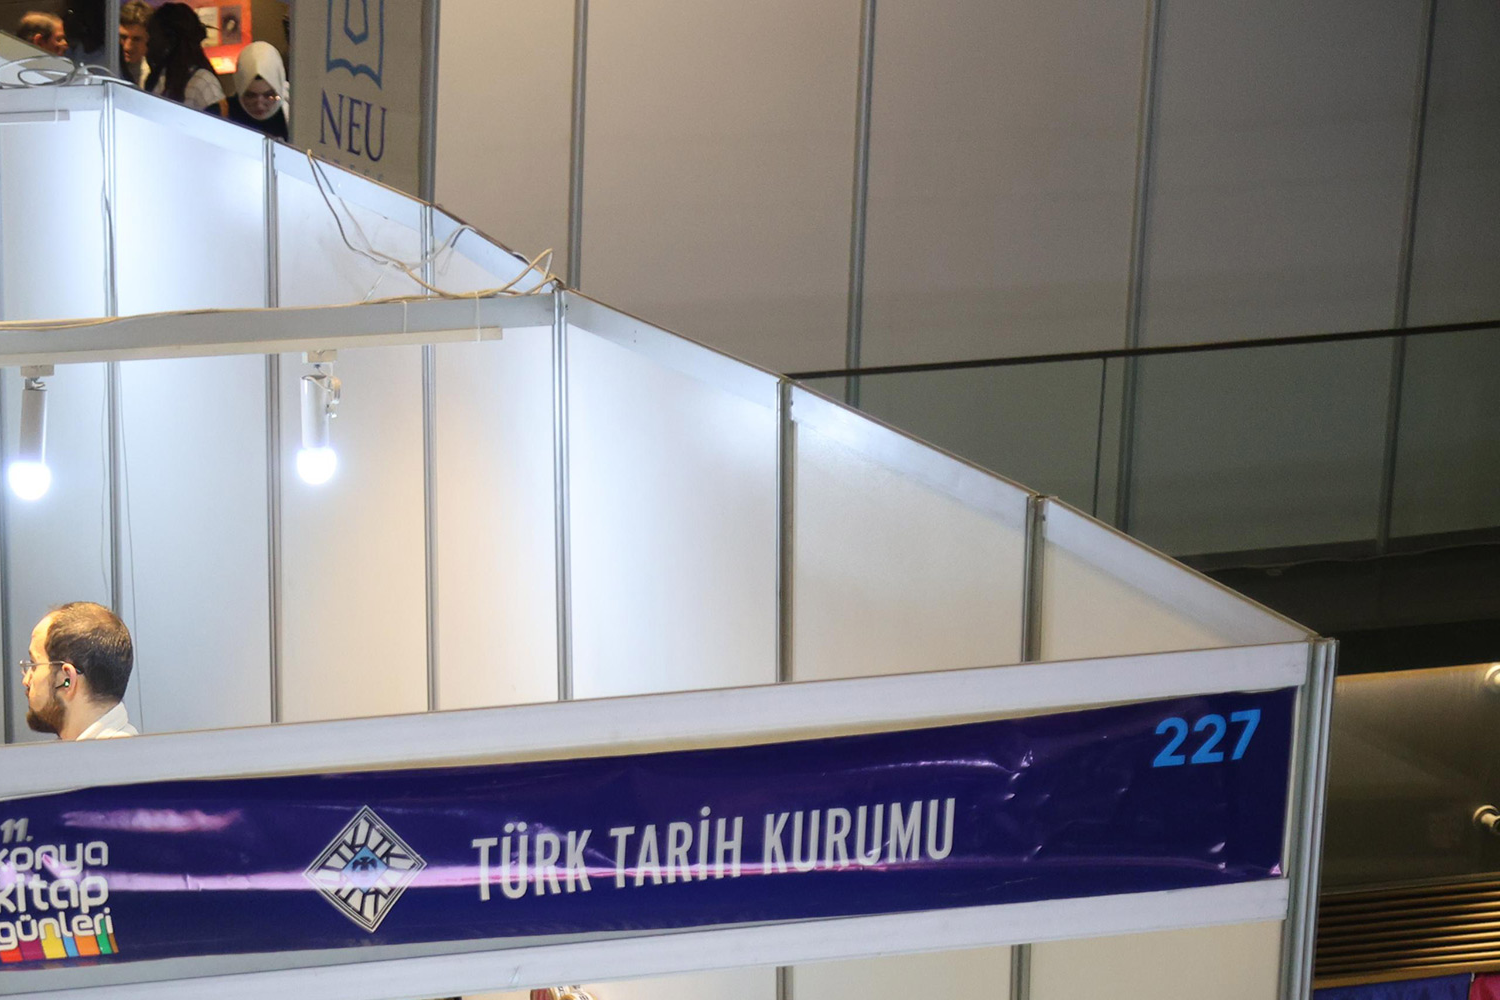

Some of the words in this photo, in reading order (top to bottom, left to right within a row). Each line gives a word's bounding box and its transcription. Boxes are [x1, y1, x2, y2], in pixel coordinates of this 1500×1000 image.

[319, 88, 387, 162] NEU
[1152, 708, 1261, 768] 227
[0, 817, 34, 844] 11.
[471, 820, 593, 902] TÜRK
[609, 805, 744, 889] TARİH
[762, 797, 956, 875] KURUMU
